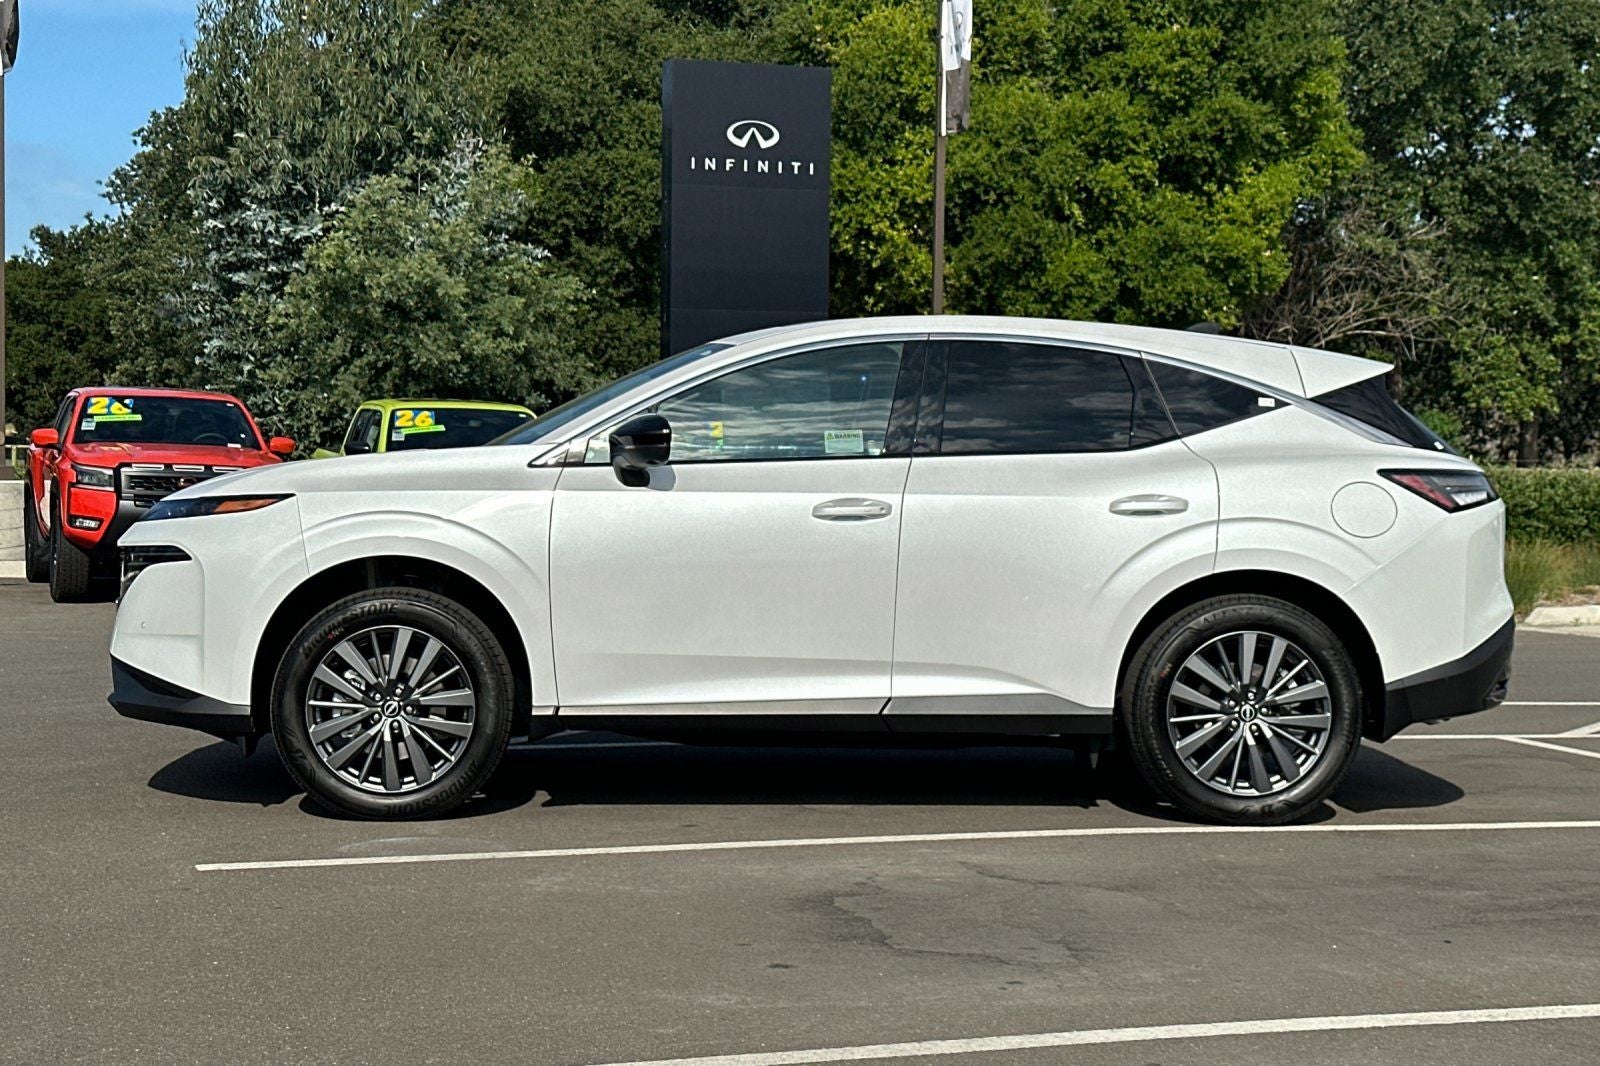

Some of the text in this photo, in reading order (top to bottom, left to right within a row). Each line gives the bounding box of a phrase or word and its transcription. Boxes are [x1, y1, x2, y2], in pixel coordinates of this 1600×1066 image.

[691, 156, 815, 176] INFINITI
[395, 409, 433, 427] 26
[834, 432, 861, 440] WARNING
